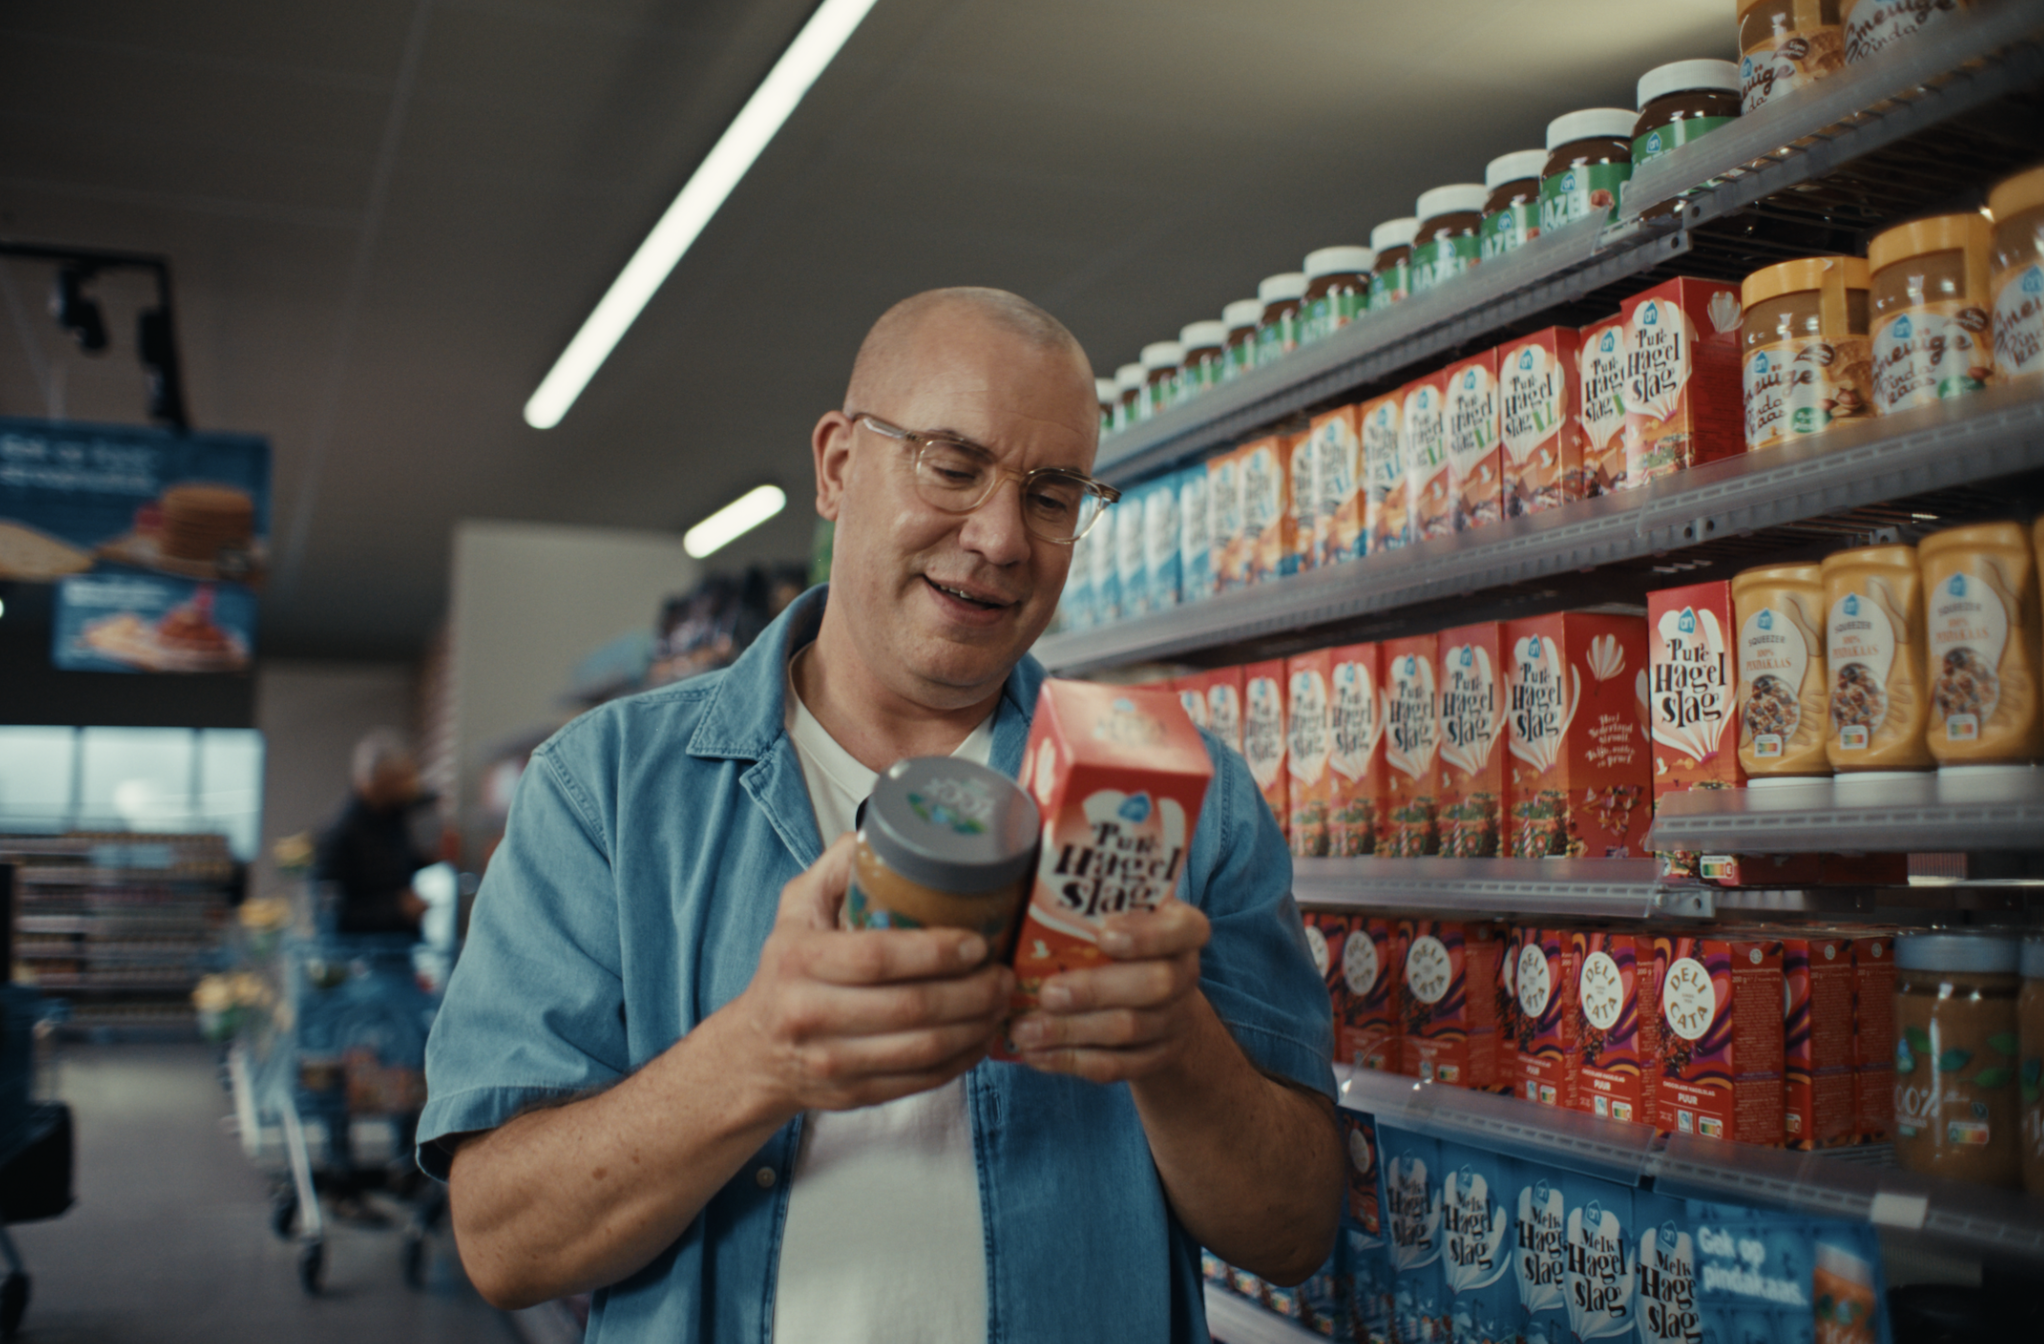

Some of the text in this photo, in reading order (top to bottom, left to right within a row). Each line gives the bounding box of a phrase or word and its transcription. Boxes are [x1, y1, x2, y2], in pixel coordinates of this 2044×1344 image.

[1635, 328, 1668, 349] Pure
[1627, 332, 1680, 379] Hagel
[1505, 372, 1553, 419] Hagel
[1633, 368, 1677, 404] slag
[1666, 638, 1709, 664] Pure
[1747, 634, 1786, 648] SQUEEZER
[1451, 670, 1482, 692] Pure
[1519, 662, 1552, 684] Pure
[1654, 652, 1727, 694] Hagel
[1389, 691, 1435, 724] Hagel
[1443, 682, 1493, 719] Hagel
[1511, 675, 1562, 711] Hagel
[1662, 689, 1722, 728] slag
[1394, 718, 1433, 752] slag
[1447, 714, 1490, 747] slag
[1516, 708, 1560, 743] slag
[1091, 821, 1159, 854] Pure
[1053, 843, 1181, 886] Hagel
[1057, 876, 1160, 917] slag
[1412, 943, 1446, 966] DELI
[1520, 951, 1546, 976] DELI
[1584, 959, 1616, 985] DELI
[1670, 966, 1707, 993] DELI
[1520, 983, 1546, 1013] CATA
[1584, 992, 1619, 1021] CATA
[1669, 1001, 1709, 1031] CATA
[1677, 1092, 1698, 1105] PUUR
[1894, 1084, 1939, 1118] 00%
[1441, 1198, 1493, 1241] Hagel
[1530, 1206, 1561, 1230] Melk
[1450, 1235, 1493, 1271] slag
[1514, 1218, 1563, 1260] Hage
[1580, 1228, 1615, 1253] Melk
[1563, 1238, 1628, 1286] Hagel
[1654, 1249, 1692, 1277] Melk
[1575, 1276, 1627, 1319] slag
[1635, 1261, 1697, 1311] Hage
[1648, 1301, 1703, 1344] slag
